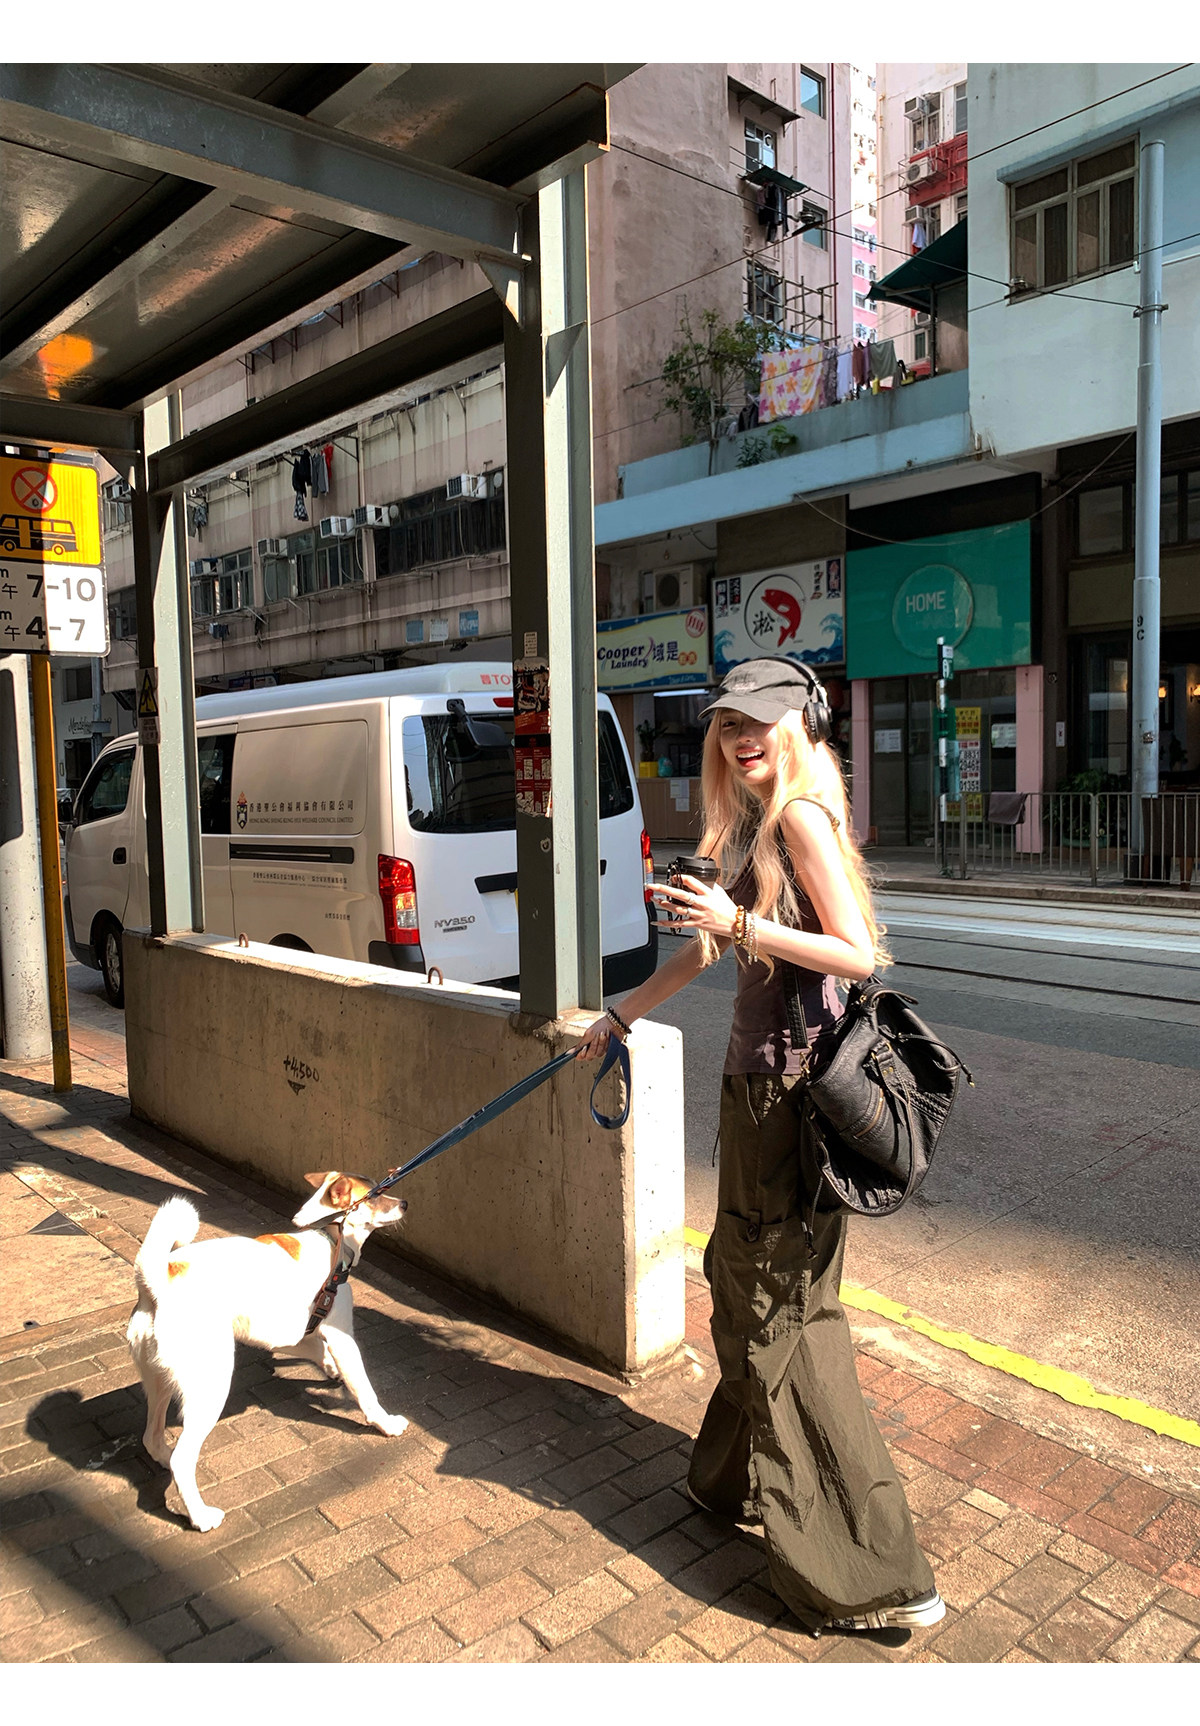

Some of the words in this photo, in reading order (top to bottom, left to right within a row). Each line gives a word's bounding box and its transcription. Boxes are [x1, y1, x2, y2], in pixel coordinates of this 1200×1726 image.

[2, 583, 18, 599] 午
[906, 590, 946, 614] HOME
[4, 625, 20, 641] 午
[597, 645, 644, 661] Cooper
[611, 657, 648, 669] Laundry
[434, 915, 475, 928] NV350
